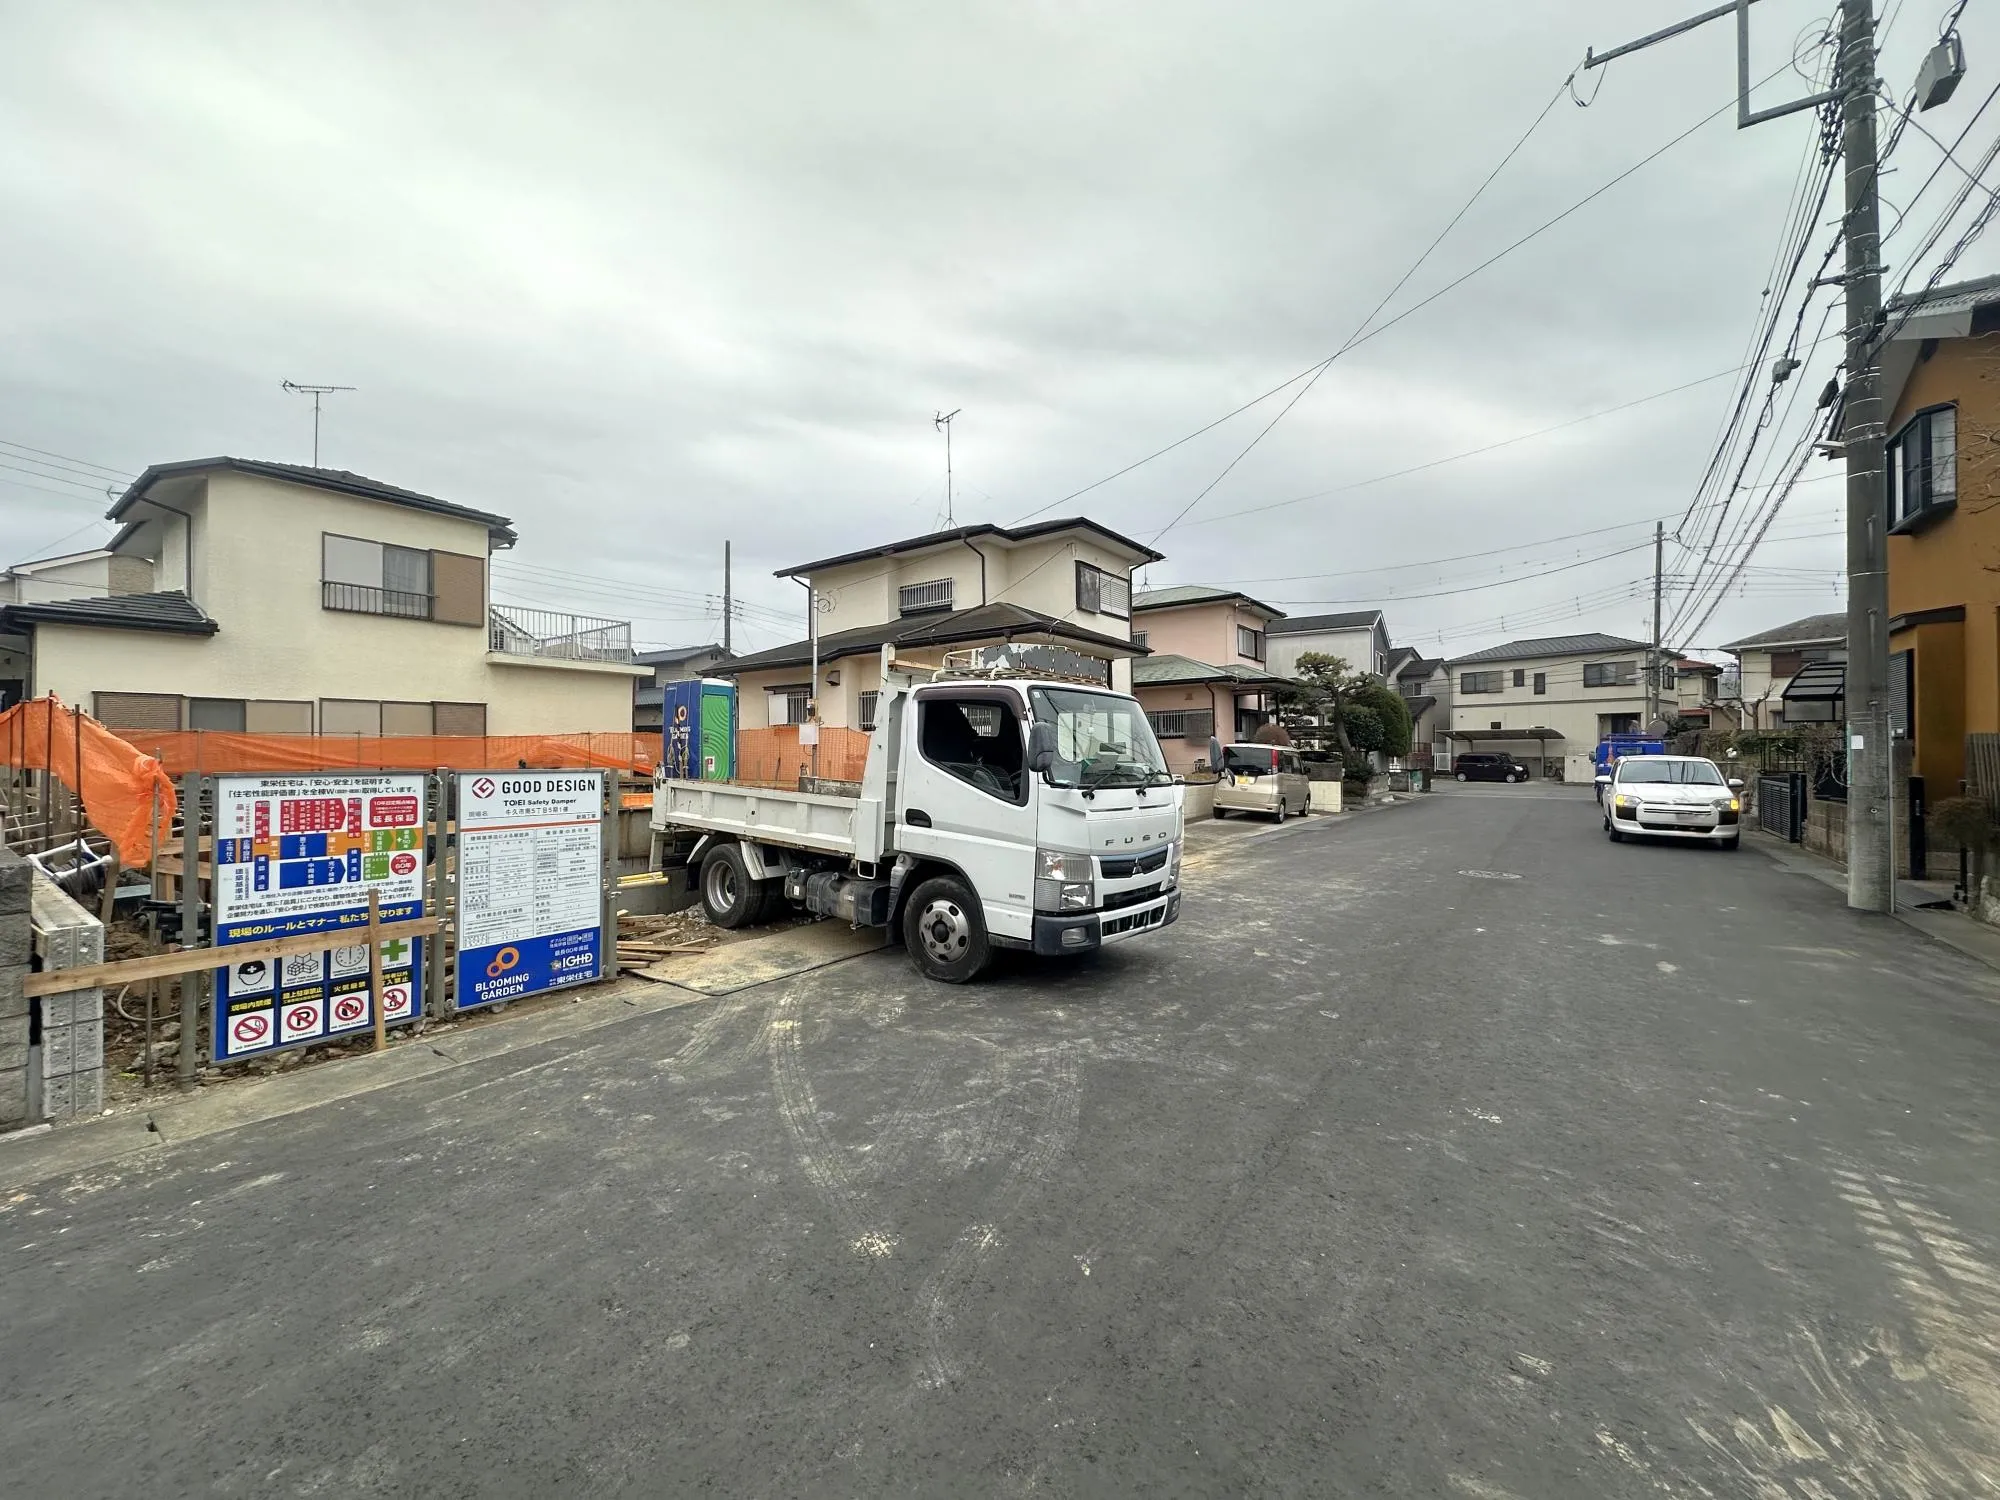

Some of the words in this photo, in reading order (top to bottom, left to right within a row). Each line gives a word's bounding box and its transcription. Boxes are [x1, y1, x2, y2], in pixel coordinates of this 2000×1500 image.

[502, 780, 542, 794] GOOD
[546, 779, 596, 792] DESIGN
[527, 799, 550, 807] Safety
[551, 798, 577, 806] Damper
[1105, 831, 1167, 846] FUSO
[226, 840, 234, 863] 土地仕入
[229, 917, 337, 939] 現場のルールとマナー
[339, 907, 414, 924] 私たち守ります
[381, 970, 409, 981] 係者以外
[475, 973, 530, 992] BLOOMING
[557, 970, 593, 985] 東栄住宅
[481, 984, 524, 1001] GARDEN
[231, 998, 272, 1012] 現場内禁煙
